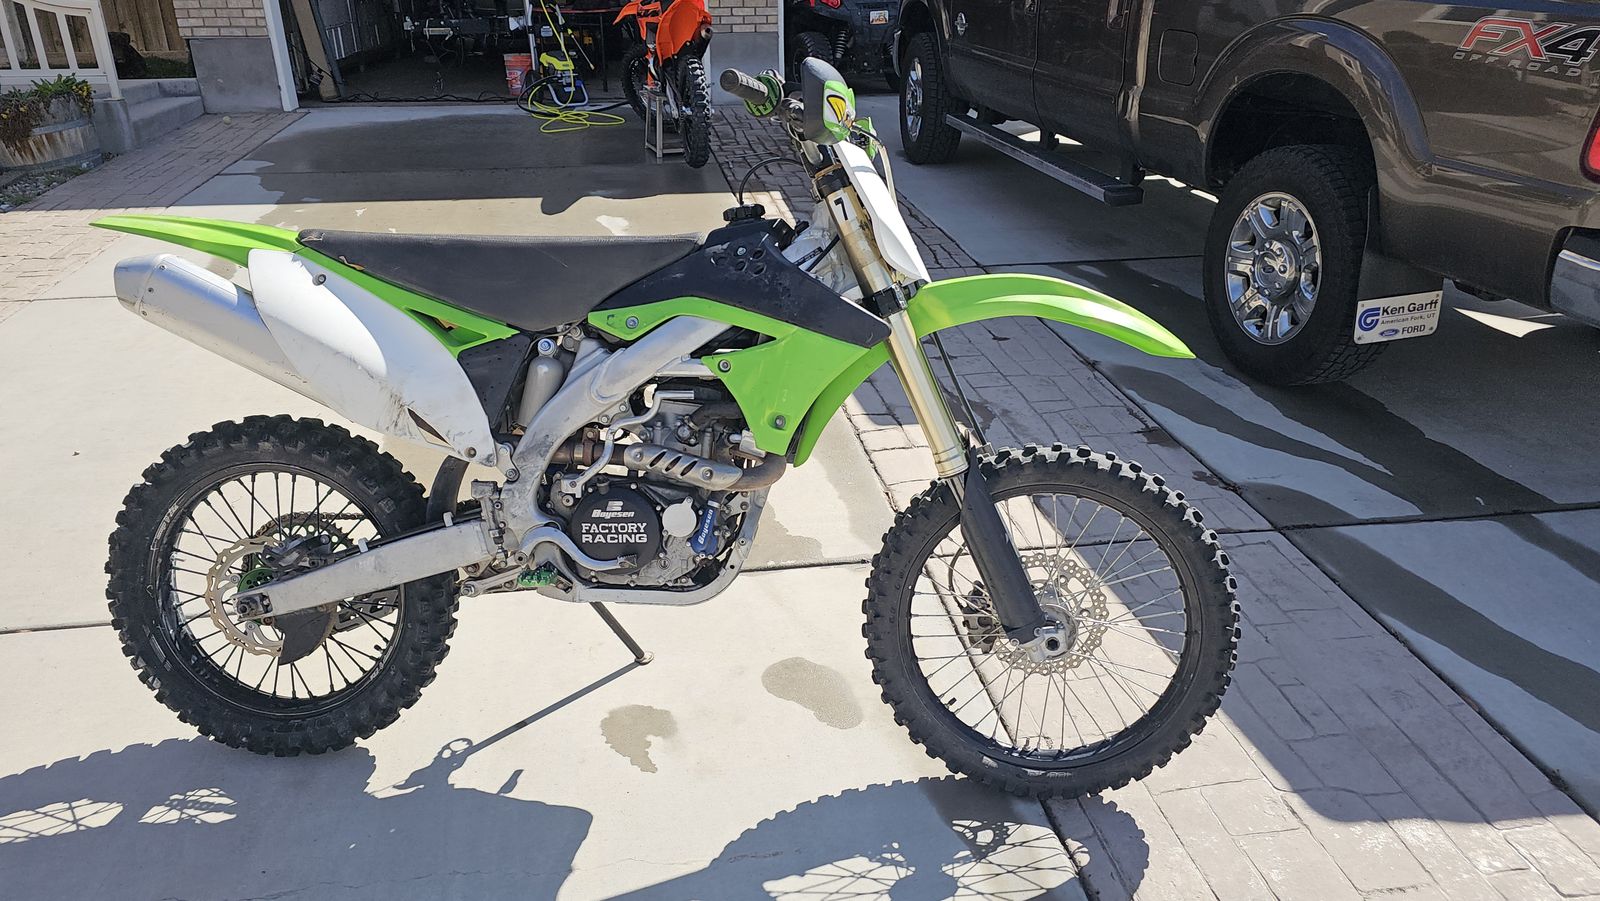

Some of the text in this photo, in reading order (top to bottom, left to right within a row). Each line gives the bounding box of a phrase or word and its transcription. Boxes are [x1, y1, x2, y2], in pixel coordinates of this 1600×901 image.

[1457, 16, 1600, 67] FX4
[1452, 51, 1583, 77] OFF ROAD
[833, 196, 849, 221] 7
[1381, 299, 1439, 316] Ken Garff
[1381, 317, 1409, 325] American
[1401, 325, 1426, 335] FORD
[591, 509, 635, 519] Boyesen
[581, 522, 647, 533] FACTORY
[697, 509, 714, 545] Boyesen
[582, 533, 648, 543] RACING
